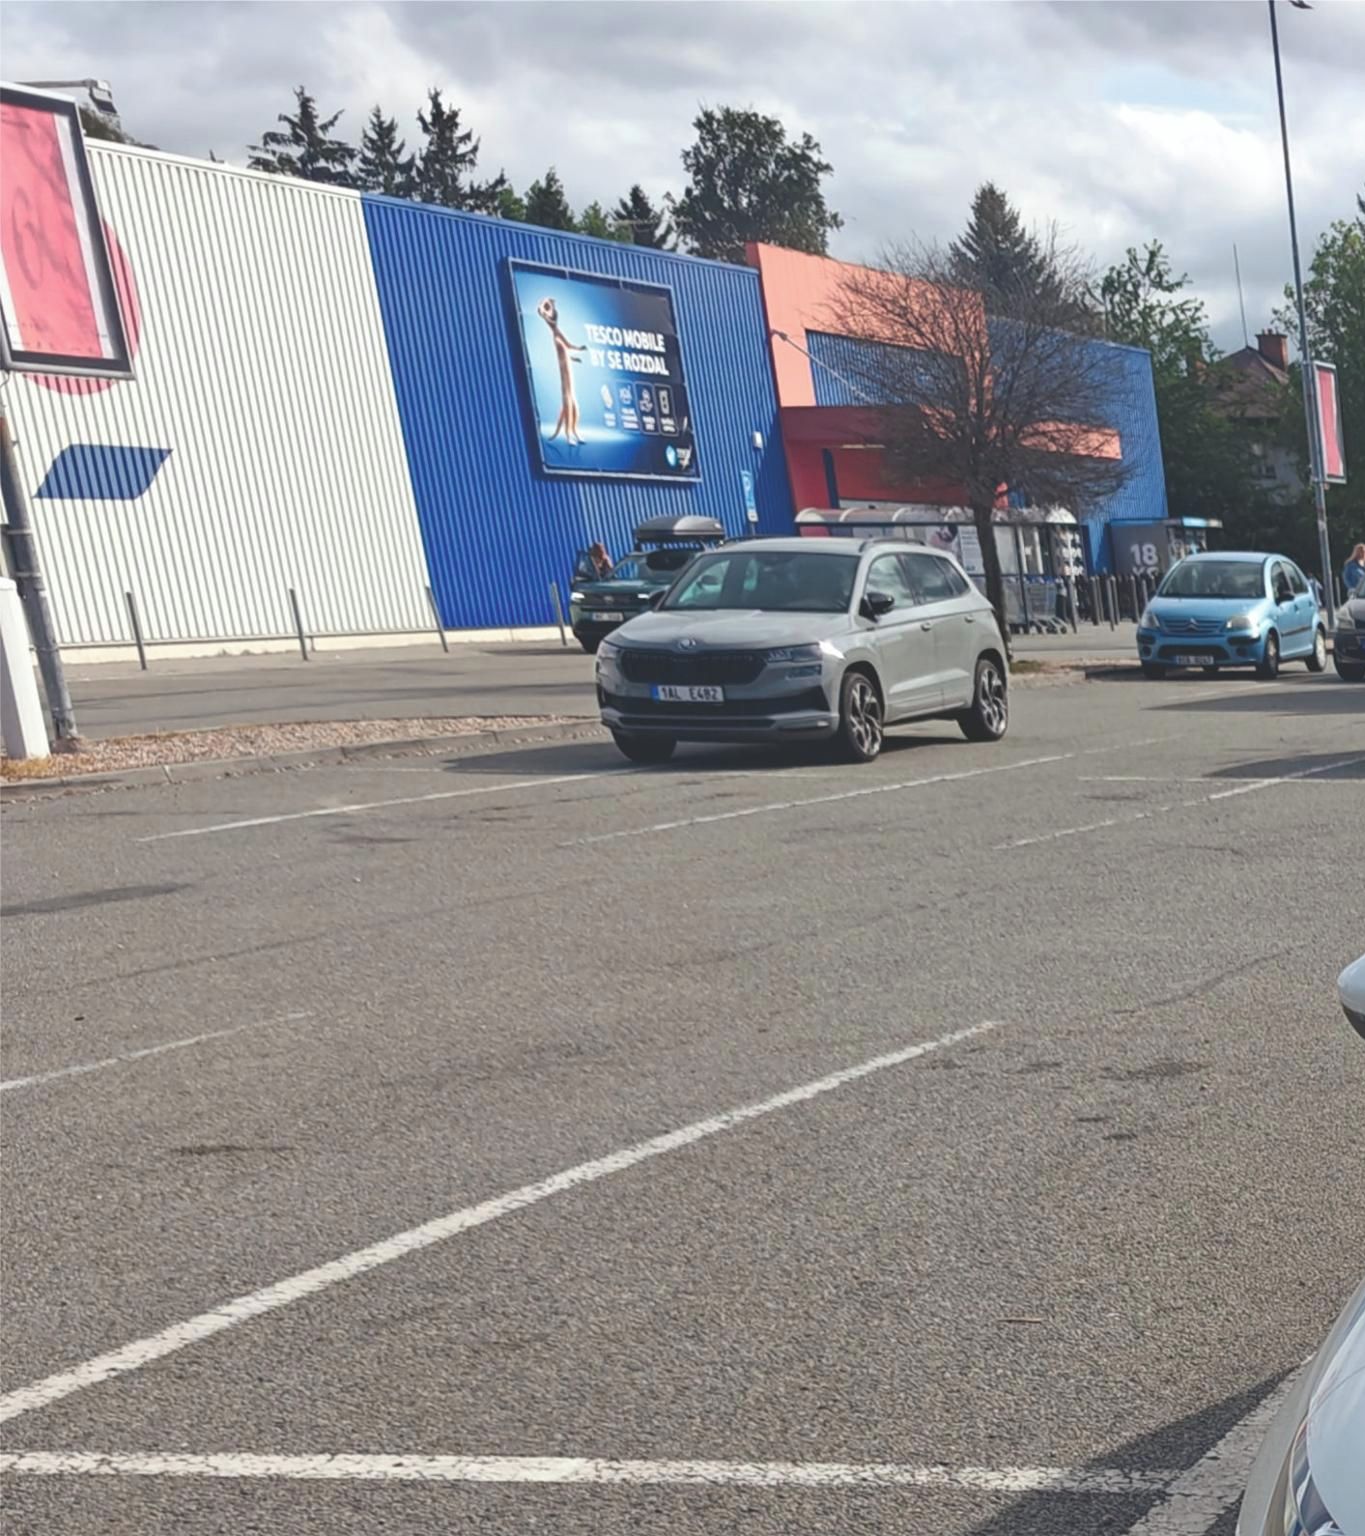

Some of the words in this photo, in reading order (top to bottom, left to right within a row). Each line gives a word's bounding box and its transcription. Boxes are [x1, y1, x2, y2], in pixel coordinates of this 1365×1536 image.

[585, 324, 623, 347] TESCO
[624, 329, 666, 353] MOBILE
[589, 349, 605, 367] BY
[608, 352, 623, 371] SE
[624, 354, 670, 376] ROZDAL
[1130, 543, 1159, 566] 18
